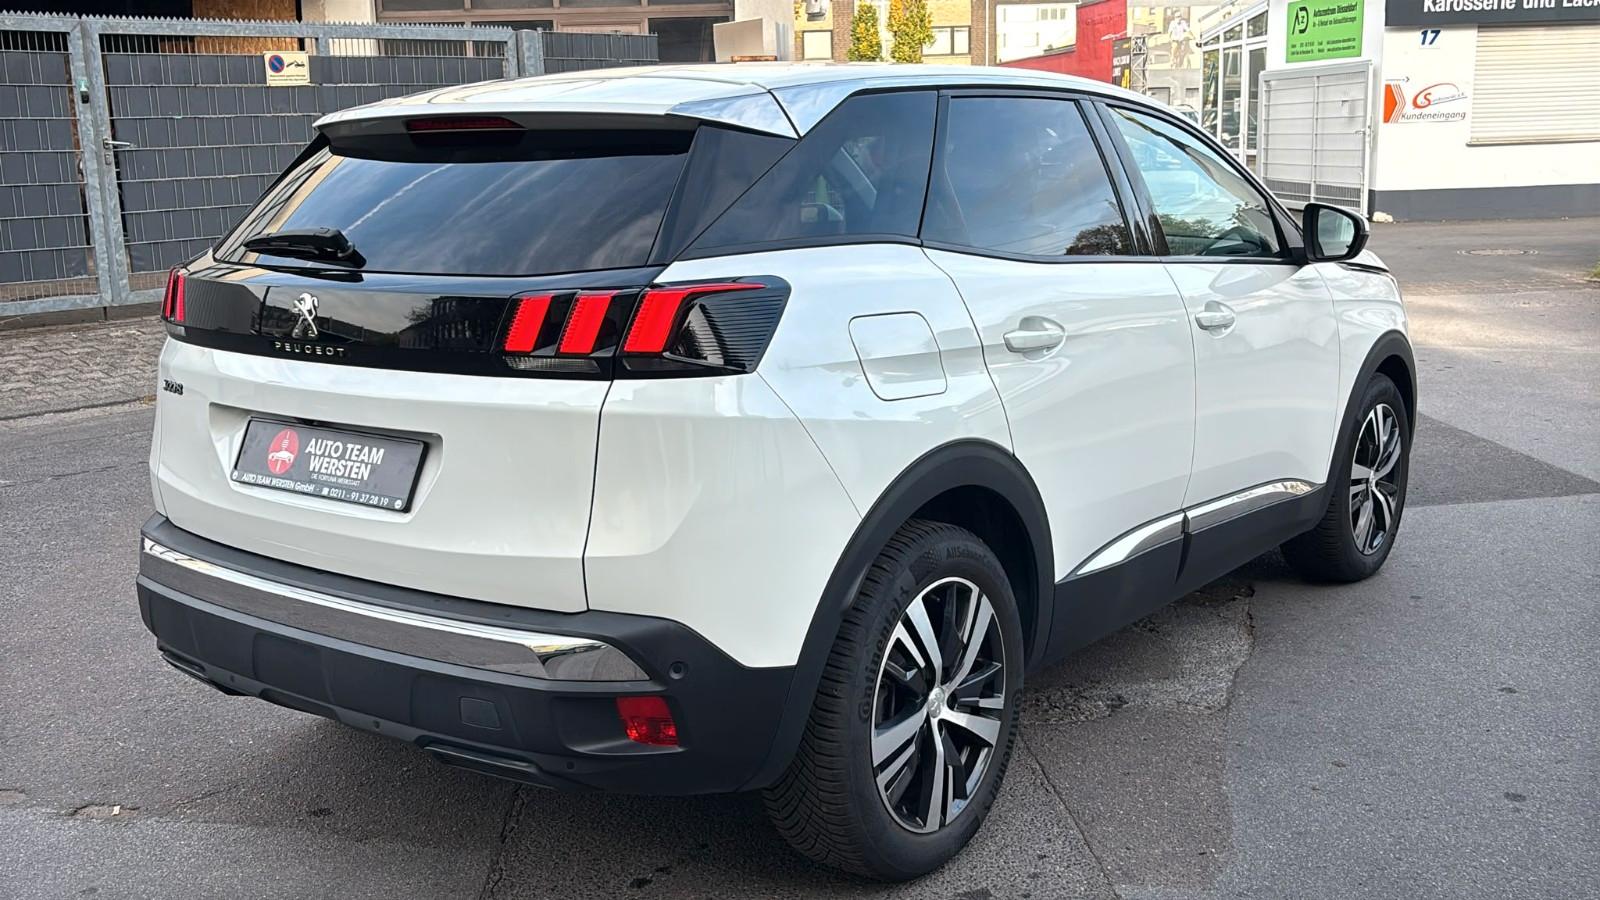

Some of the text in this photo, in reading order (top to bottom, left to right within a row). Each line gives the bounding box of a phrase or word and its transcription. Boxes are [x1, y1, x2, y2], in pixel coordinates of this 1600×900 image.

[1423, 0, 1515, 12] Karosserie
[1522, 0, 1555, 9] und
[1420, 30, 1441, 46] 17
[1401, 111, 1466, 121] Kundeneingang
[274, 341, 345, 357] PEUGEOT
[304, 438, 385, 465] AUTO TEAM
[309, 455, 371, 481] WERSTEN
[241, 473, 256, 482] AUTO
[256, 475, 272, 485] TEAM
[271, 478, 296, 489] WERSTEN
[295, 482, 315, 493] GmbH
[329, 488, 346, 499] 0211
[351, 491, 360, 501] 91
[360, 493, 370, 503] 37
[369, 495, 379, 505] 28
[380, 497, 389, 506] 19
